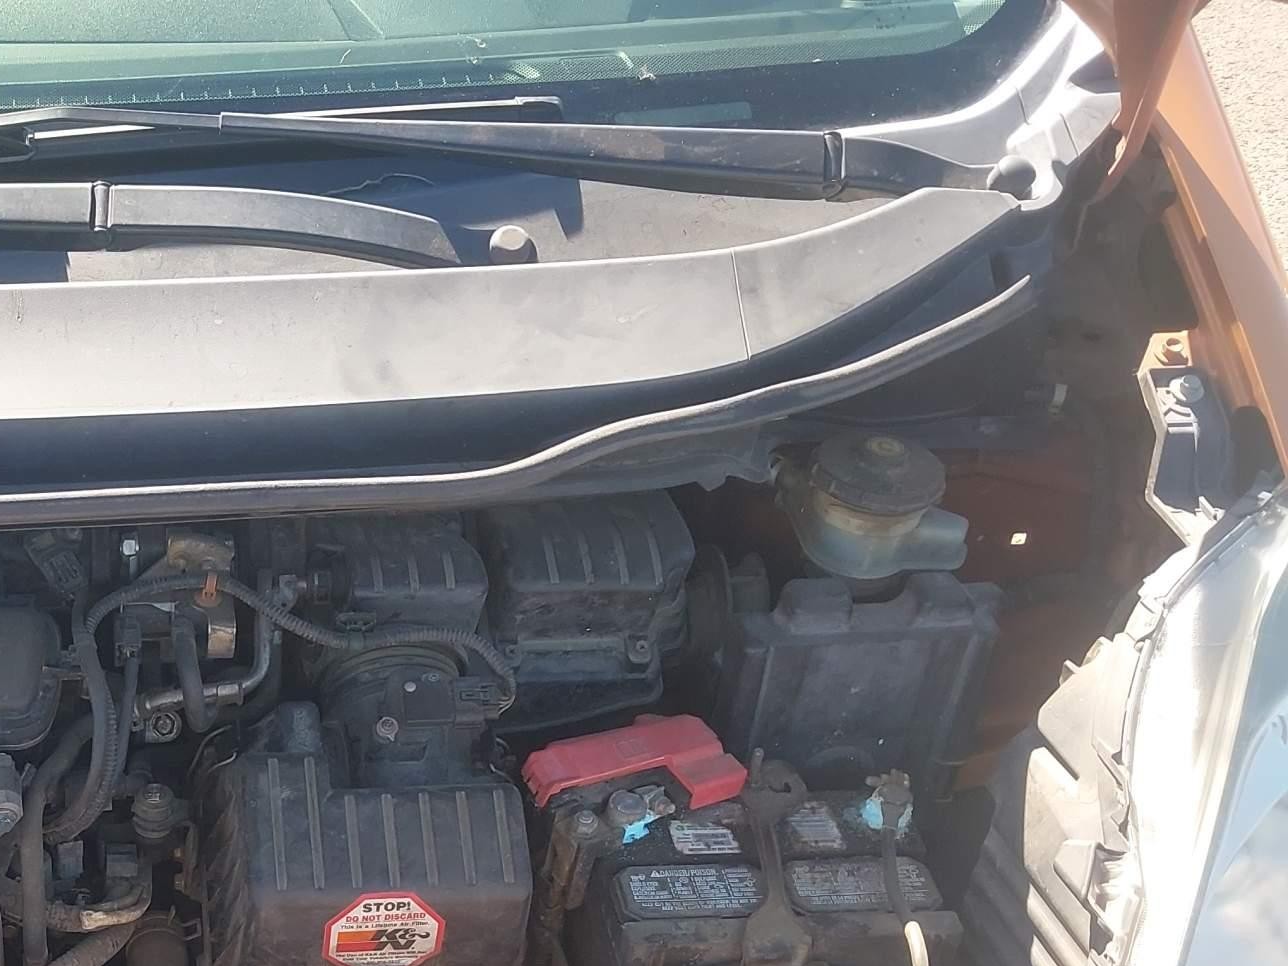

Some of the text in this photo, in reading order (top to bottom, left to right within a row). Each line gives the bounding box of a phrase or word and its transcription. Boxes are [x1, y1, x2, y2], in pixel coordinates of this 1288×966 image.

[363, 901, 411, 912] STOP!
[345, 912, 426, 923] DO NOT DISCARD
